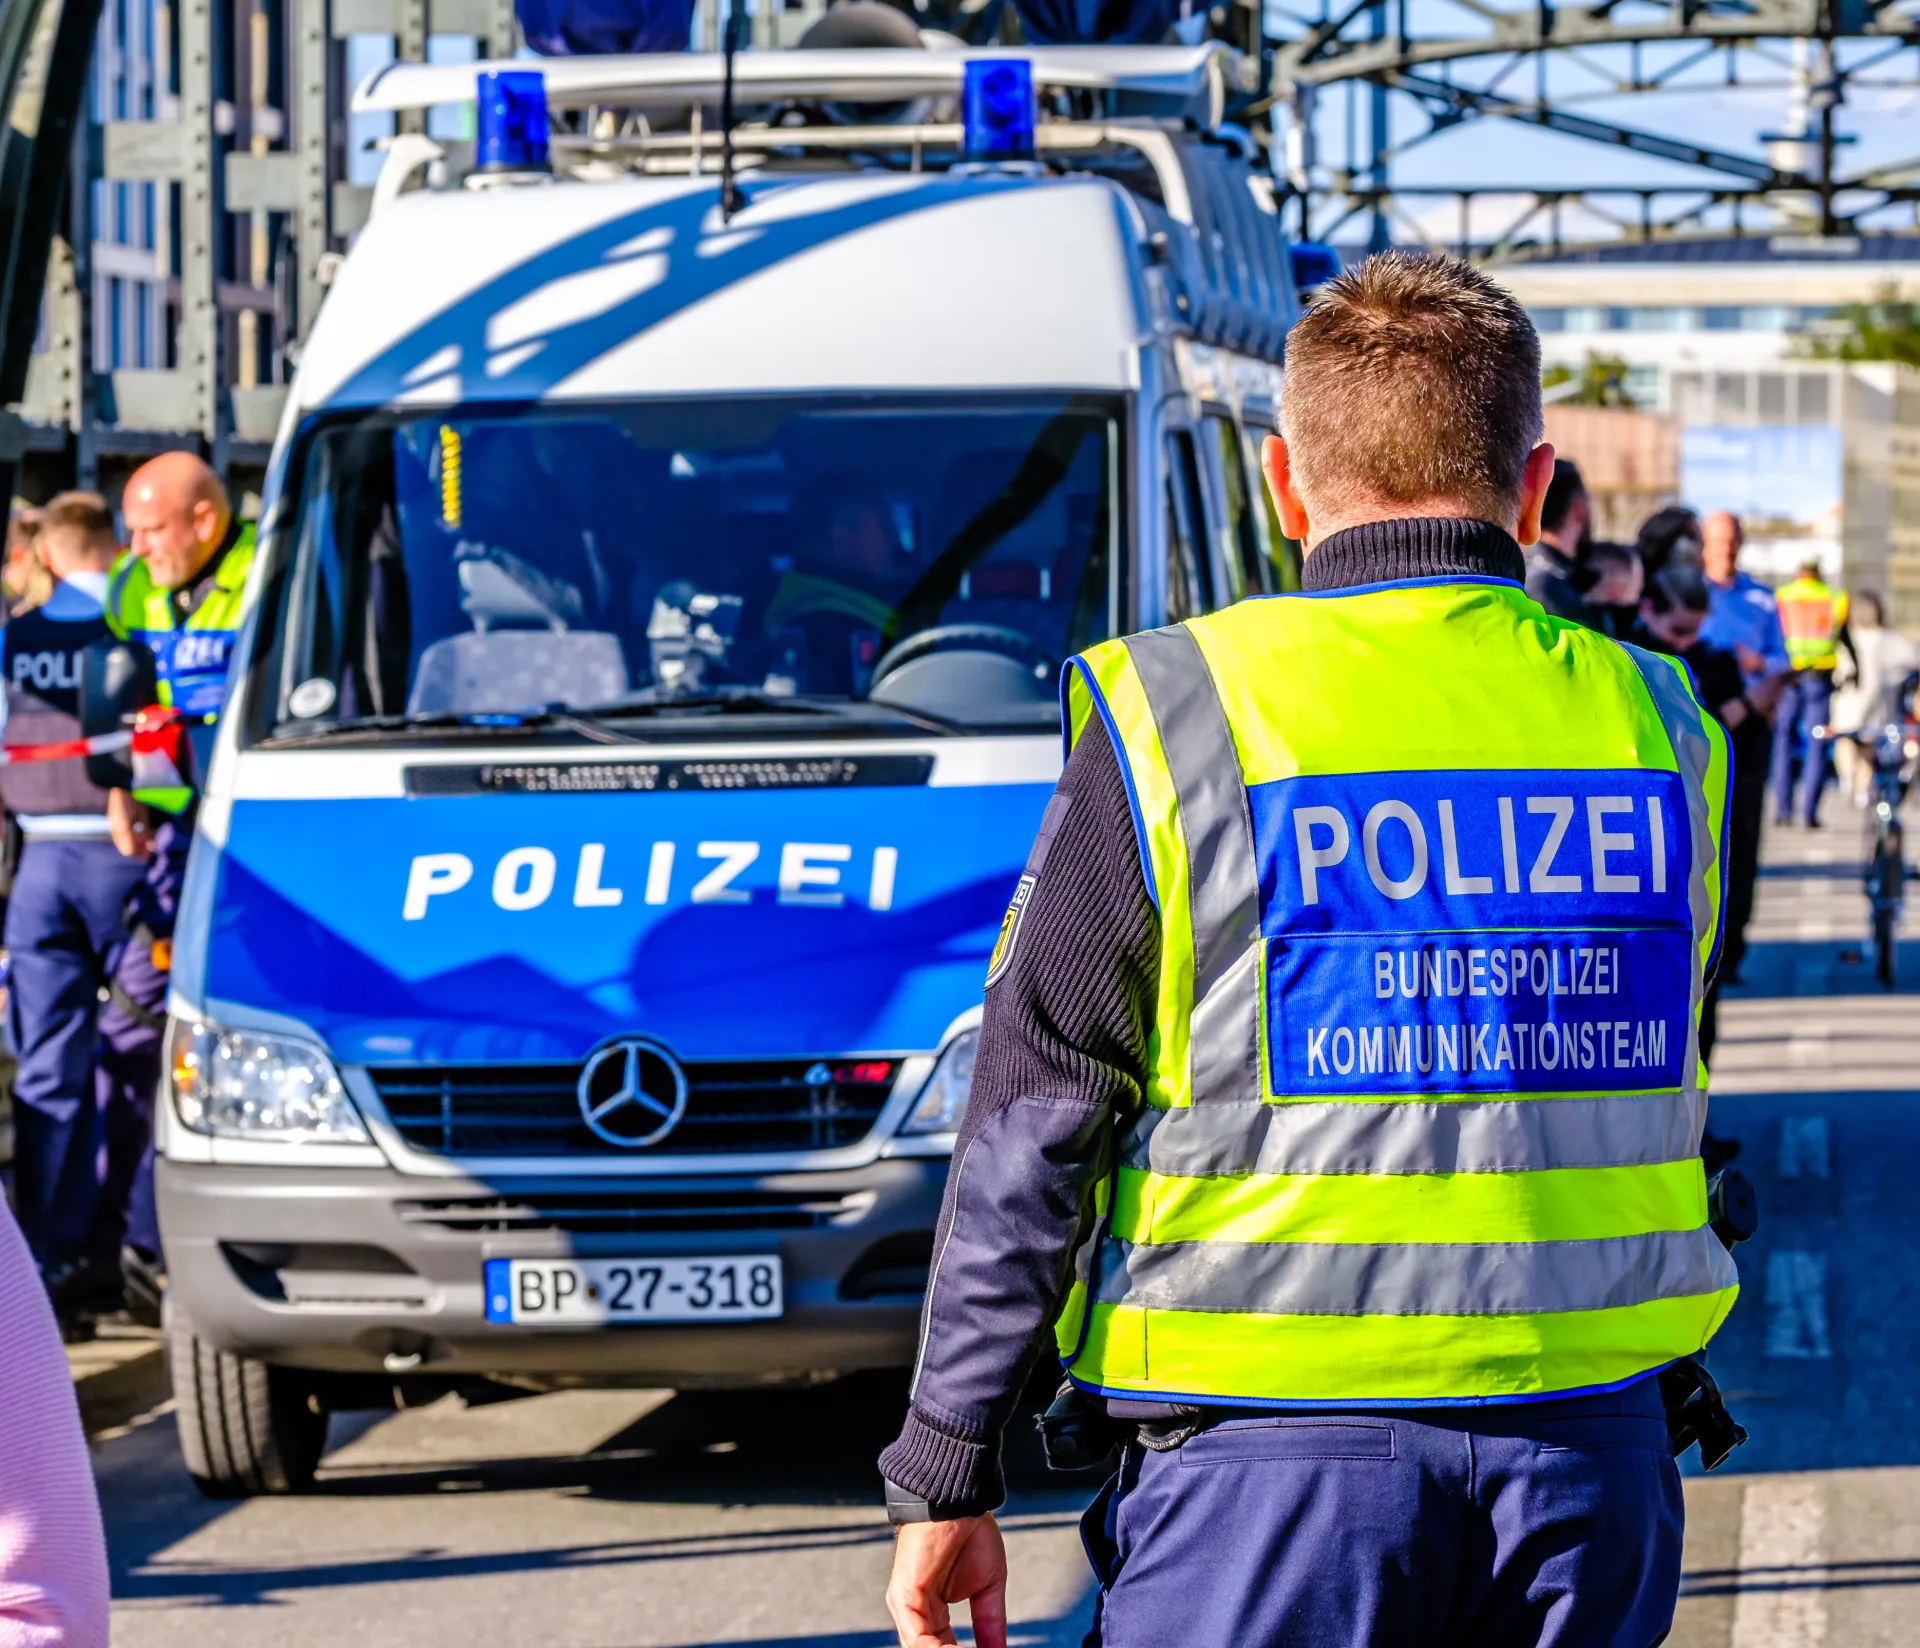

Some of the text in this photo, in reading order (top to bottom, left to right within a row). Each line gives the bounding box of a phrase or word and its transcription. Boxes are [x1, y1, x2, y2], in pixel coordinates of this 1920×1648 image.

[1292, 794, 1669, 907] POLIZEI
[402, 841, 898, 921] POLIZEI
[1374, 946, 1620, 999] BUNDESPOLIZEI
[1306, 1019, 1668, 1077] KOMMUNIKATIONSTEAM
[518, 1269, 577, 1312] BP
[607, 1264, 775, 1311] 27-318
